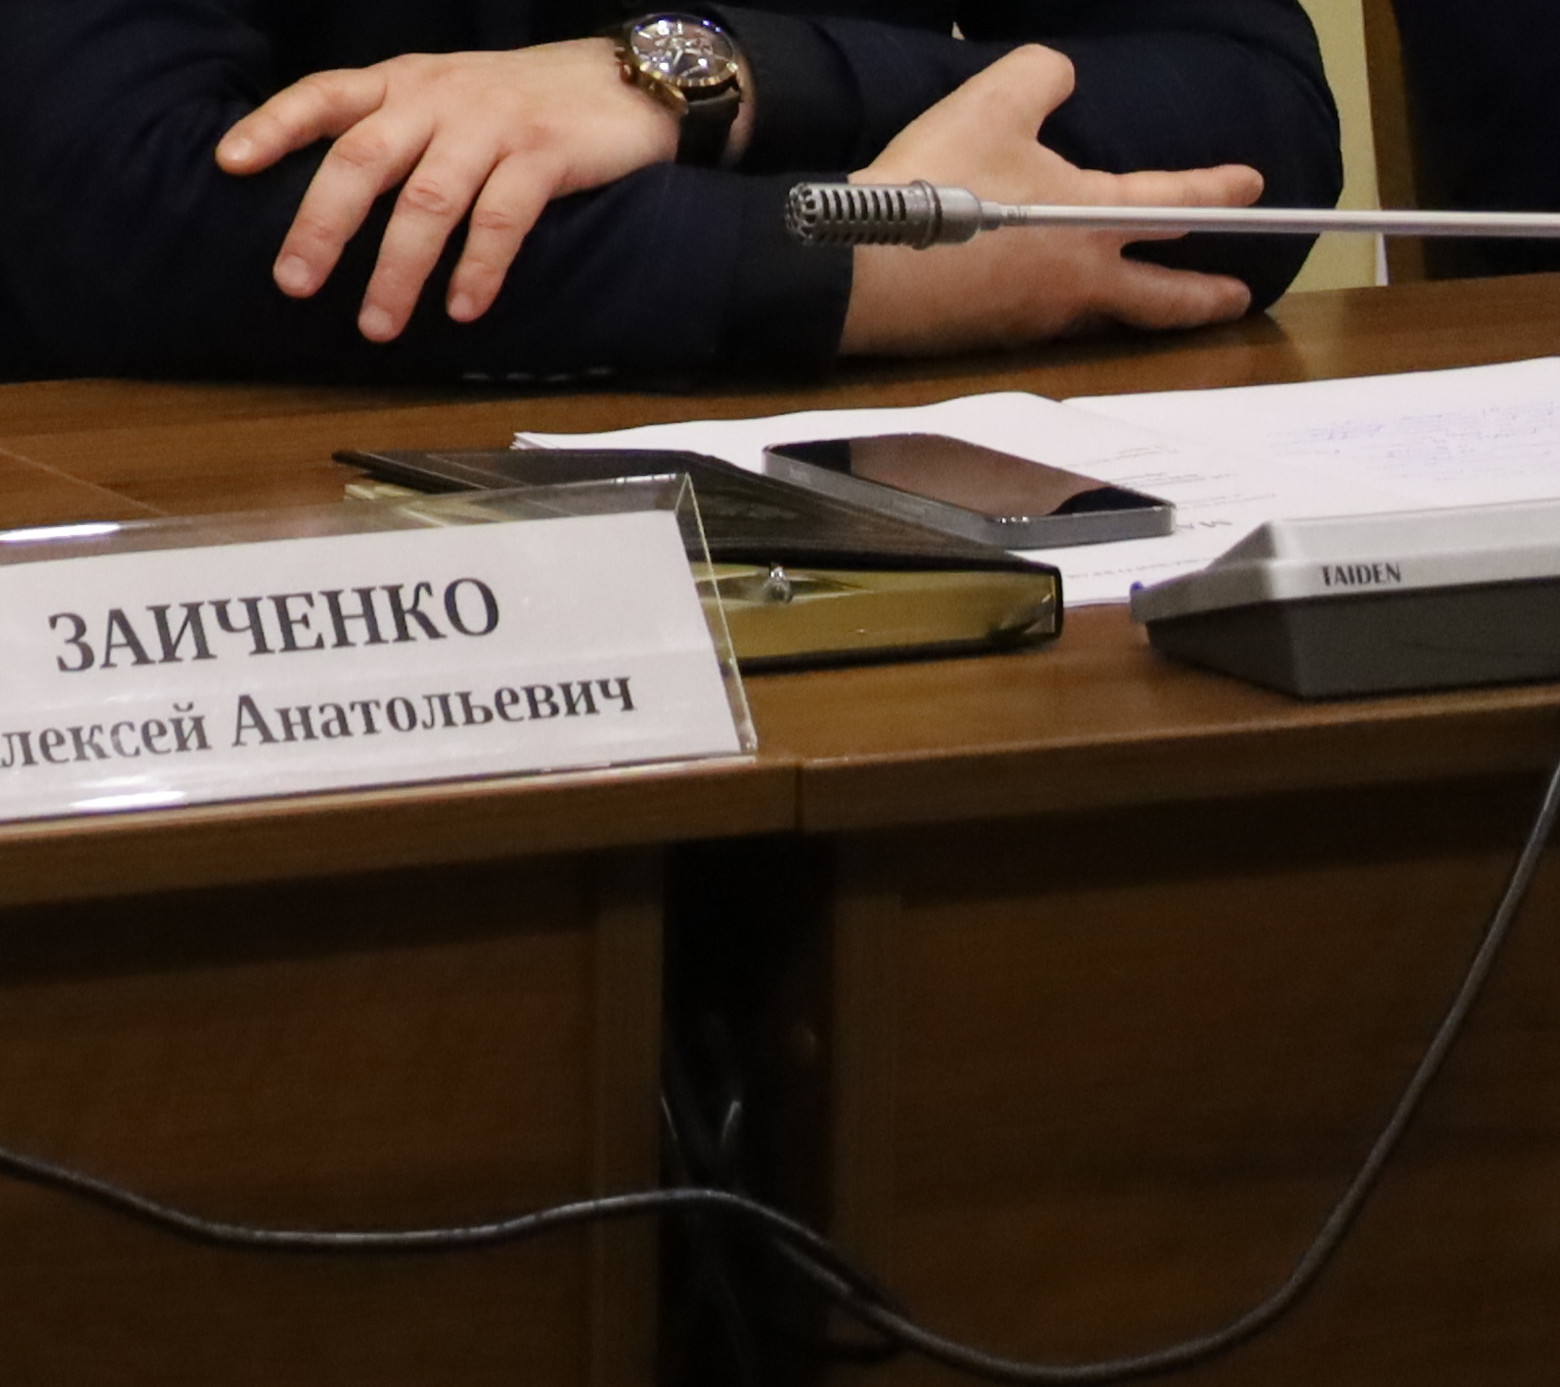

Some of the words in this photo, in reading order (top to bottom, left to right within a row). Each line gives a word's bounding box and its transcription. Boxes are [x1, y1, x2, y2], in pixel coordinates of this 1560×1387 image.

[1322, 562, 1401, 586] TAIDEN
[47, 577, 500, 672] ЗАИЧЕНКО
[232, 675, 638, 747] Анатольевич
